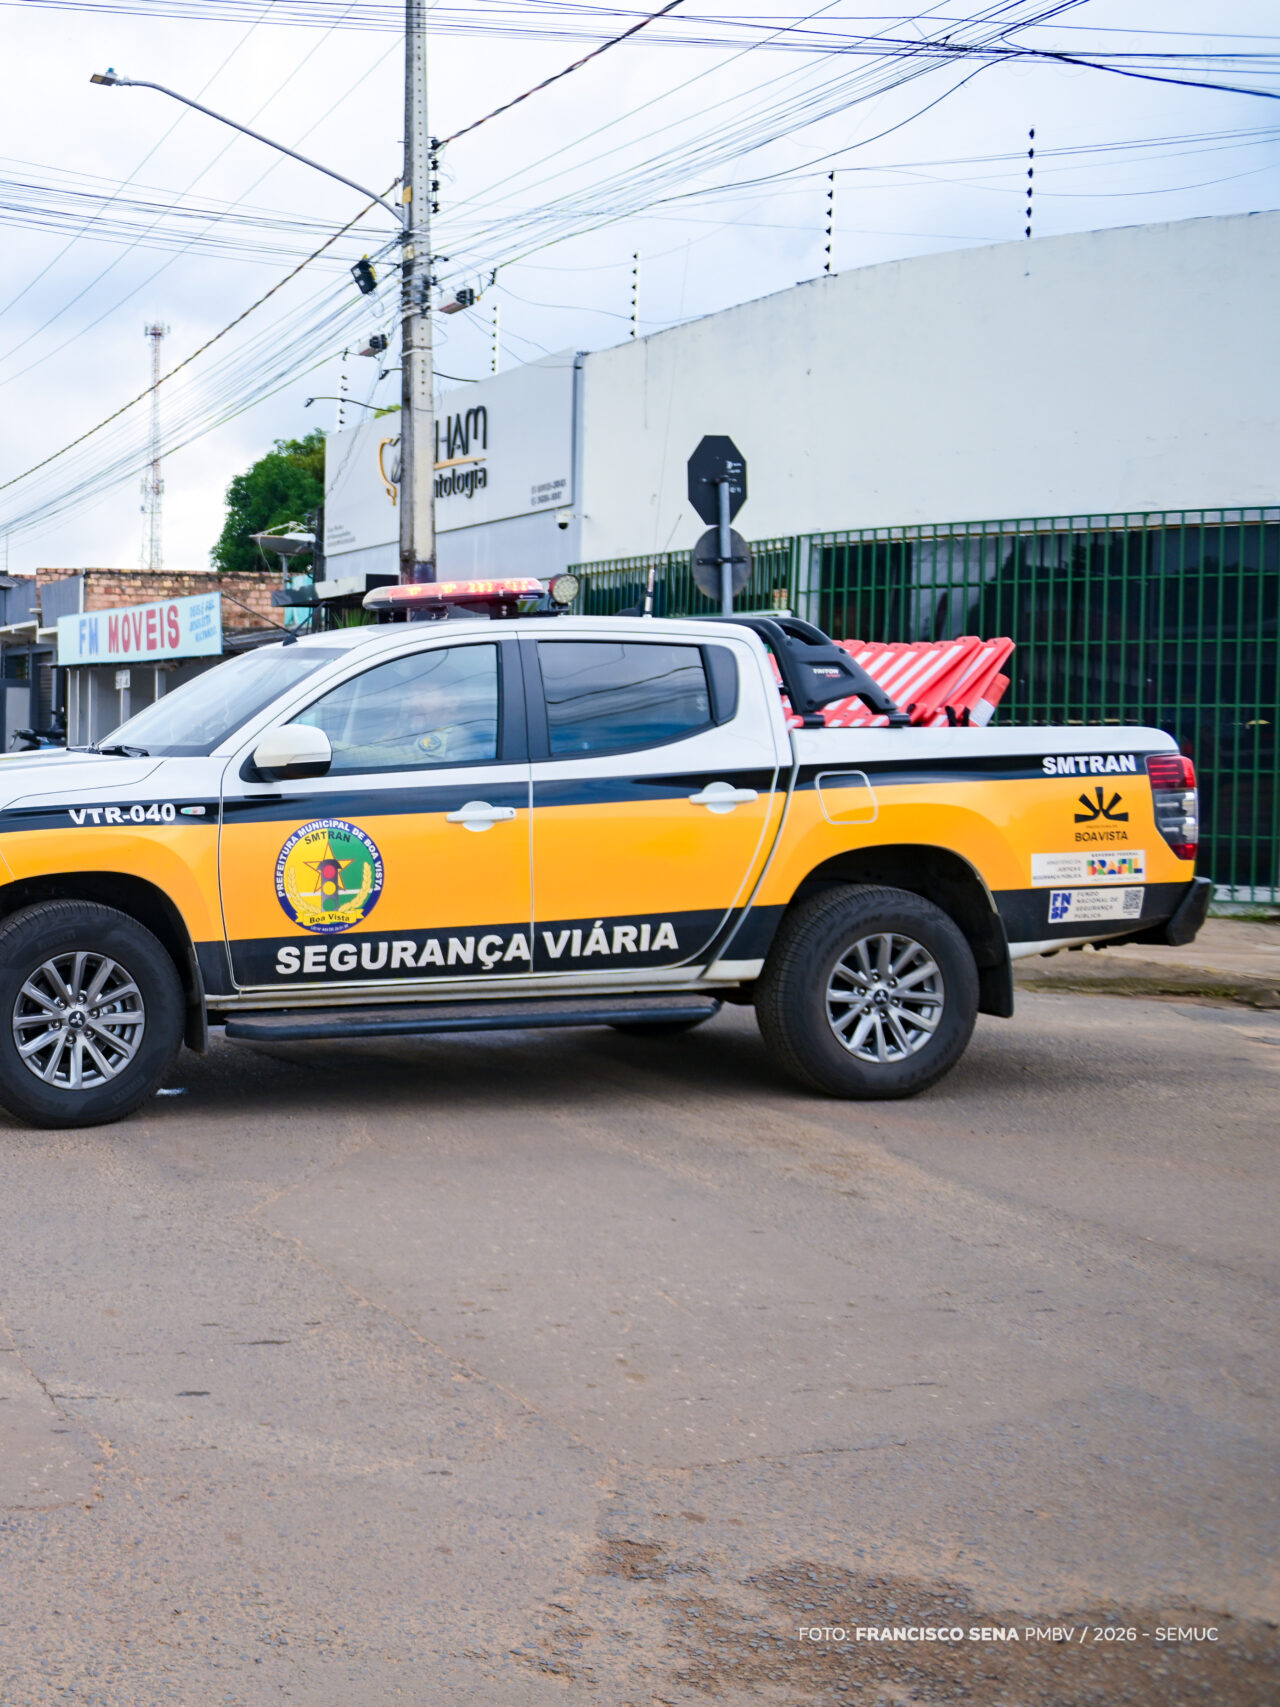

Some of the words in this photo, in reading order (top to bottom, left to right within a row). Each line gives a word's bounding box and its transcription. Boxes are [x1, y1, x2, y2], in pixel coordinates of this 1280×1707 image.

[1042, 755, 1136, 775] SMTRAN
[68, 803, 176, 825] VTR-040
[304, 830, 352, 845] SMTRAN
[275, 835, 299, 898] PREFEITURA
[297, 819, 351, 837] MUNICIPAL
[352, 827, 366, 841] DE
[364, 838, 379, 860] BOA
[373, 860, 383, 892] VISTA
[1087, 858, 1143, 876] BRASIL
[309, 915, 326, 924] Boa
[328, 913, 350, 922] Vista
[275, 932, 531, 975] SEGURANÇA
[542, 921, 680, 958] VIÁRIA
